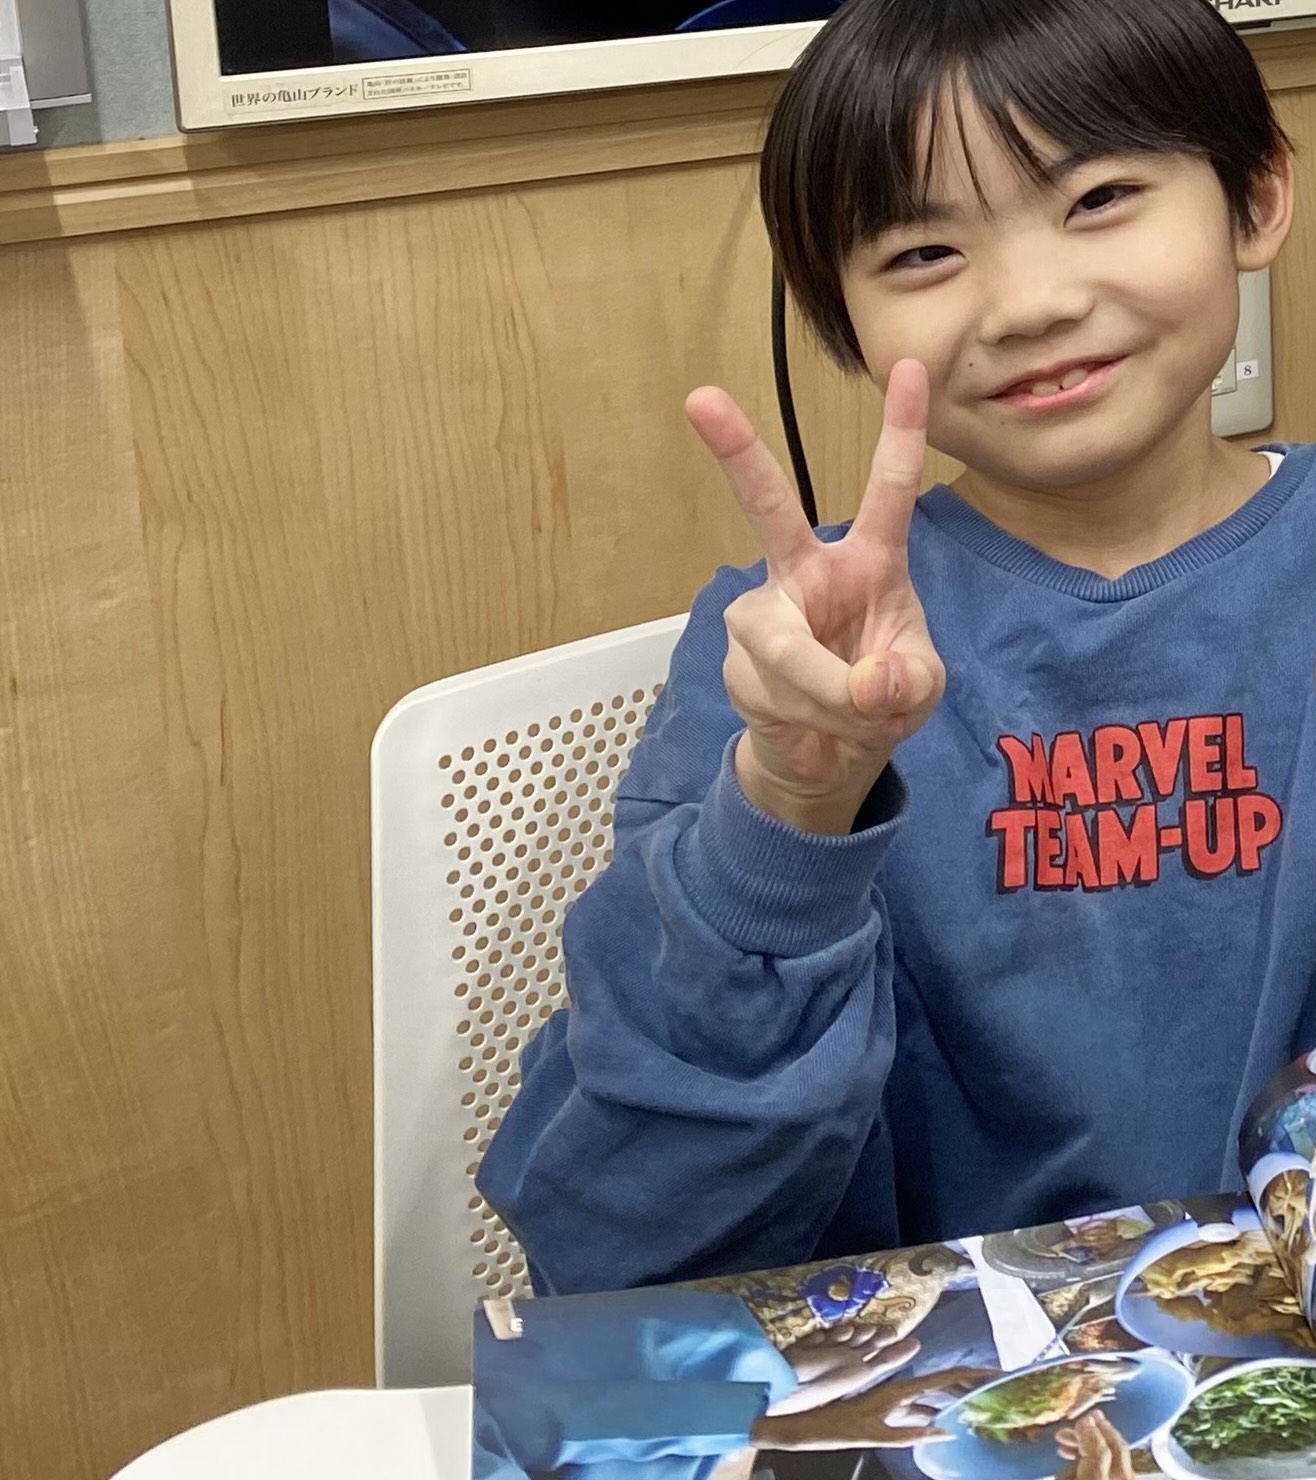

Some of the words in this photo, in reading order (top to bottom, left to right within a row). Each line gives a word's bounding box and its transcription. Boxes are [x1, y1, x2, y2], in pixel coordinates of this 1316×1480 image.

[231, 83, 359, 108] 世界の亀山ブランド
[996, 713, 1257, 807] MARVEL
[986, 793, 1284, 894] TEAM-UP
